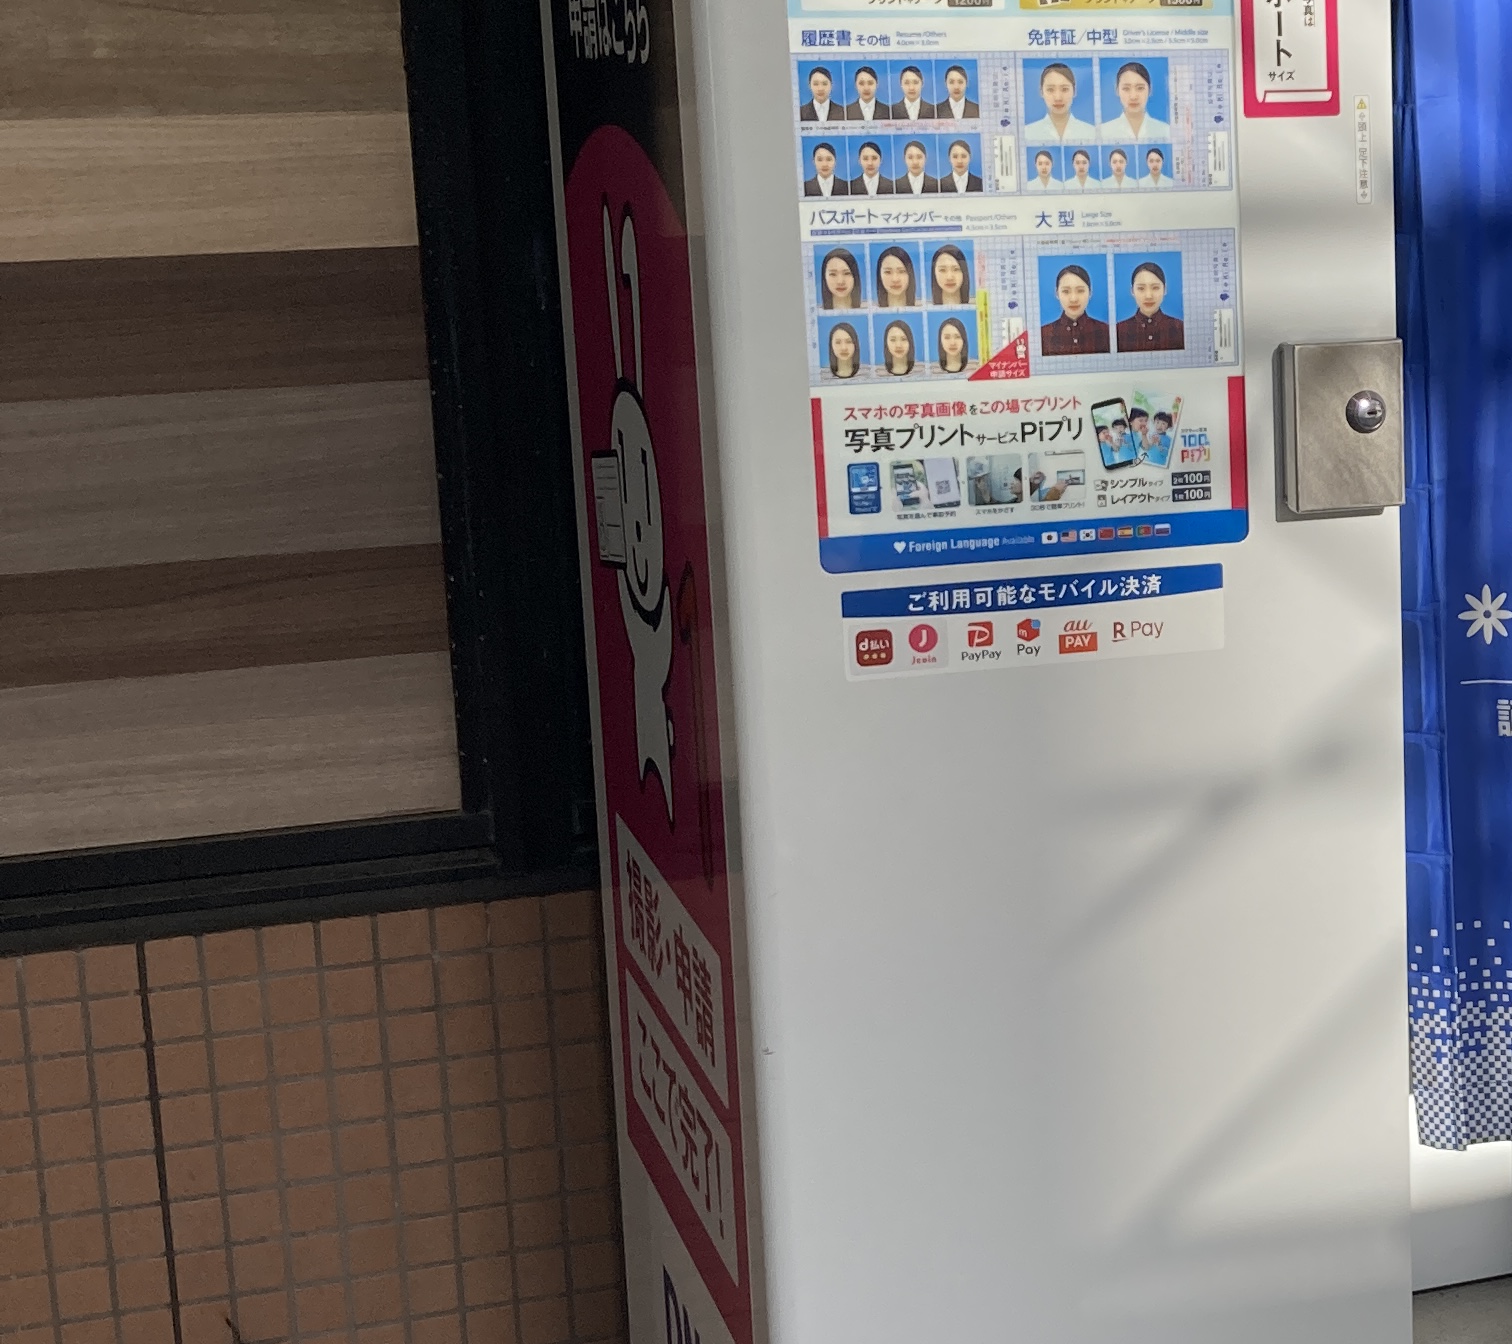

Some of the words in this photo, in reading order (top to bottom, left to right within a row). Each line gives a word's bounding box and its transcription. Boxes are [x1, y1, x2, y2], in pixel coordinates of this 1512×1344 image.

[855, 34, 891, 47] その他
[1267, 70, 1296, 82] サイズ
[810, 208, 879, 226] パスポート
[1035, 210, 1076, 229] 大型
[843, 396, 1082, 422] スマホの写真画像をこの場でプリント
[908, 540, 948, 553] Foreign
[950, 537, 1000, 552] Language
[907, 574, 1163, 613] ご利用可能なモバイル決済
[1130, 619, 1165, 639] Pay
[1017, 642, 1042, 657] Pay
[1065, 634, 1092, 649] PAY
[961, 649, 1002, 663] PayPay
